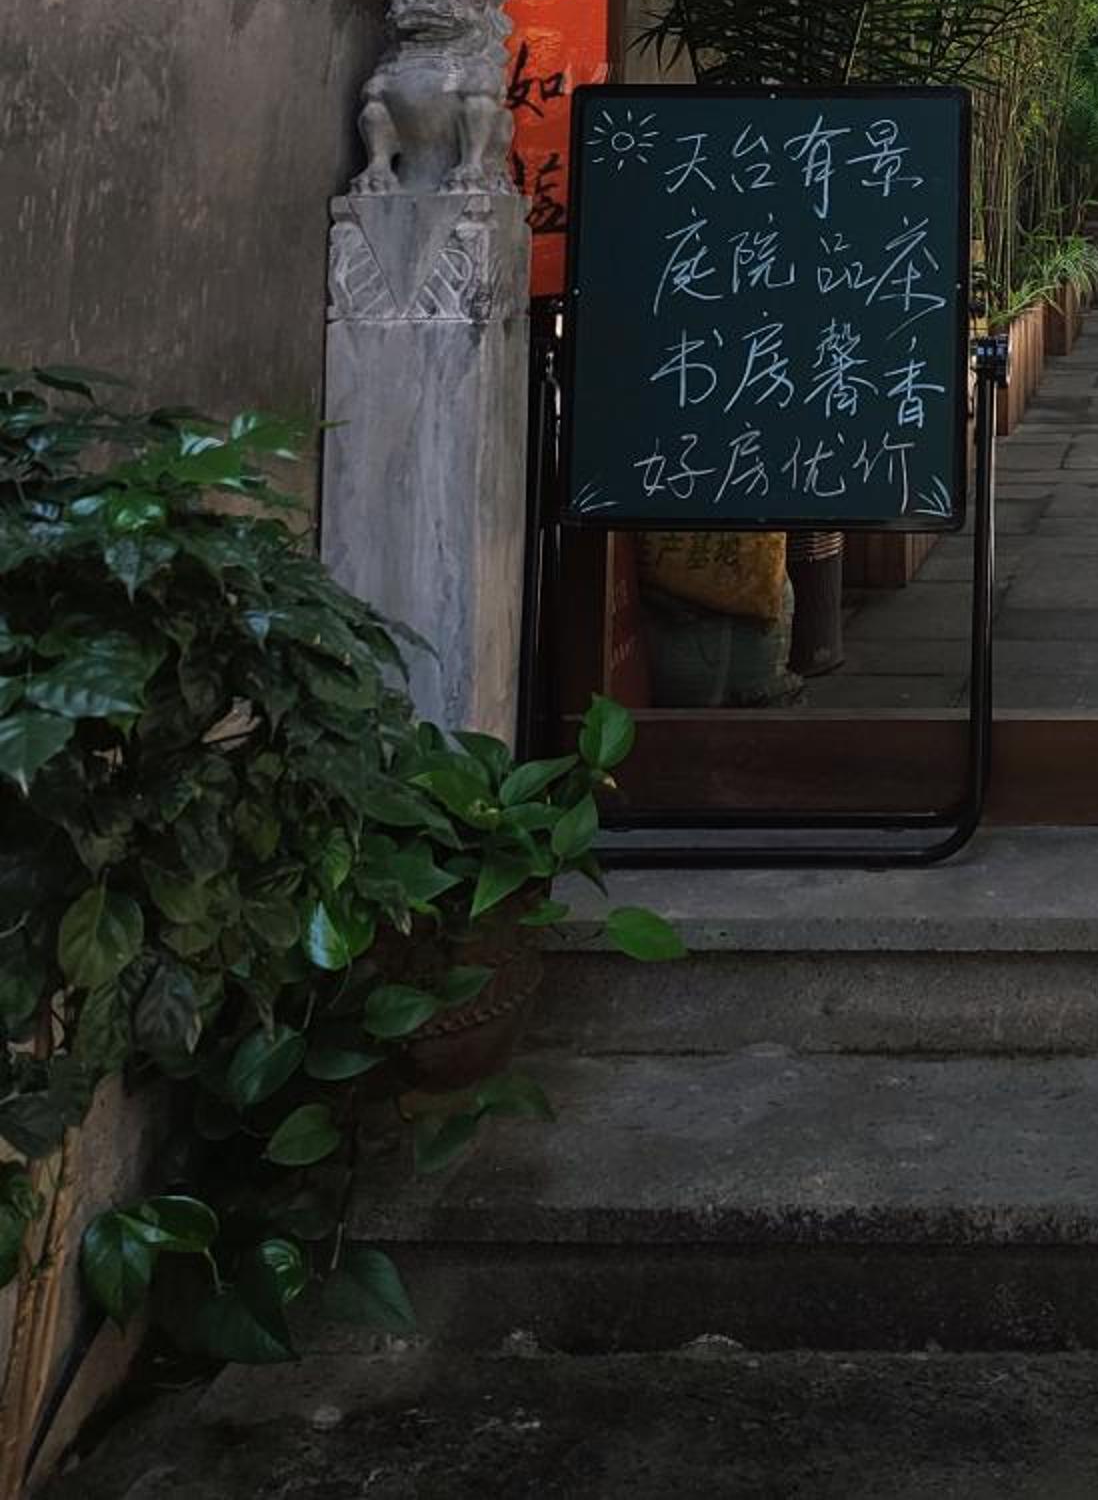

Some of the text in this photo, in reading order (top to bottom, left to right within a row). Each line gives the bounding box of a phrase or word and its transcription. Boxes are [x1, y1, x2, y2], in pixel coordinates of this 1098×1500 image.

[665, 115, 925, 219] 天台有景
[654, 206, 947, 332] 庭院品茶
[651, 310, 946, 429] 书房馨香
[634, 422, 916, 514] 好房优价
